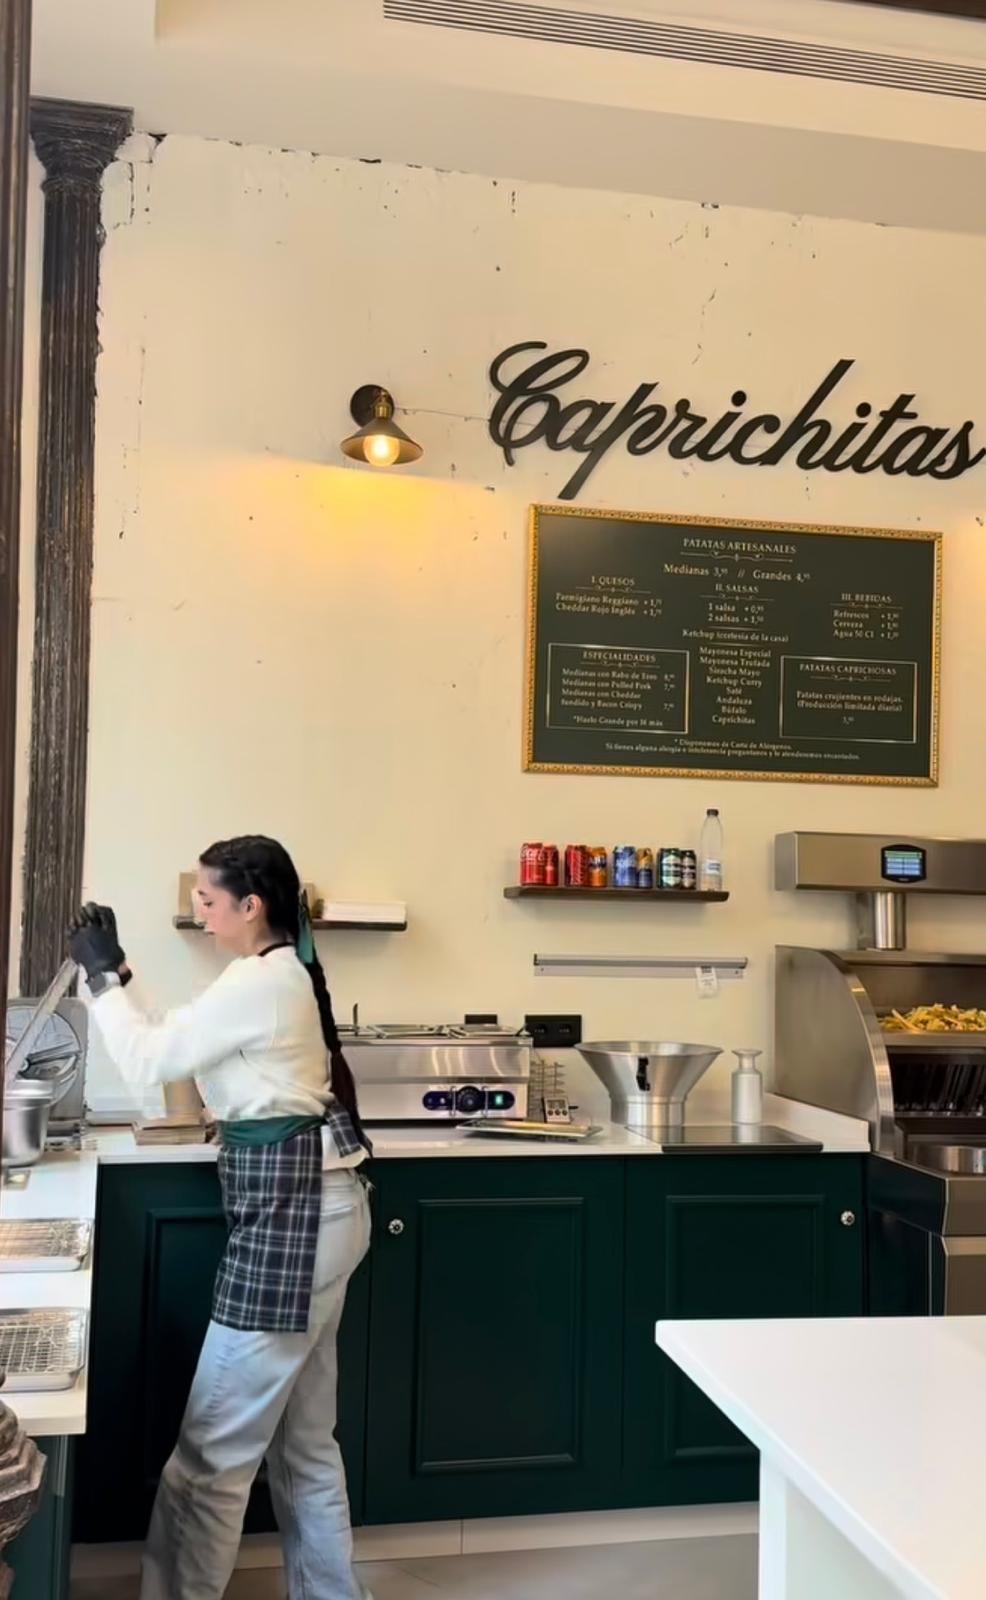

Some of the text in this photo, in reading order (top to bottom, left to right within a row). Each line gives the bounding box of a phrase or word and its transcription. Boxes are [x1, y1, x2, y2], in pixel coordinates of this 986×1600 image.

[489, 341, 986, 500] Caprichitas
[683, 538, 797, 555] PATATAS ARTESANALES
[663, 563, 710, 576] Medianas
[753, 569, 792, 581] Grandes
[599, 575, 635, 586] QUESOS
[725, 583, 759, 593] SALSAS
[555, 592, 601, 604] Parmigiano
[602, 595, 639, 606] Reggiano
[855, 593, 893, 603] BEBIDAS
[555, 602, 590, 613] Cheddar
[591, 605, 610, 616] Rojo
[715, 603, 735, 612] salsa
[715, 613, 740, 623] salsas
[833, 619, 863, 628] Cerveza
[682, 629, 715, 640] Ketchup
[750, 632, 760, 641] de
[761, 633, 769, 641] la
[833, 629, 853, 639] Agua
[582, 650, 657, 663] ESPECIALIDADES
[699, 646, 771, 659] Mayonesa Especial
[699, 656, 770, 668] Mayonesa Trufada
[562, 668, 596, 677] Medianas
[611, 671, 629, 680] Rabo
[631, 672, 640, 680] de
[739, 668, 761, 678] Mayo
[799, 663, 896, 675] PATATAS CAPRICHOSAS
[562, 678, 596, 687] Medianas
[611, 680, 634, 689] Pulled
[706, 675, 762, 688] Ketchup Curry
[561, 688, 596, 697] Medianas
[611, 690, 641, 699] Cheddar
[797, 690, 823, 699] Patatas
[824, 692, 861, 702] crujientes
[597, 700, 618, 708] Bacon
[716, 696, 753, 705] Andaluza
[844, 701, 876, 711] limitada
[598, 716, 625, 725] Grande
[626, 719, 638, 727] por
[712, 714, 756, 726] Caprichitas
